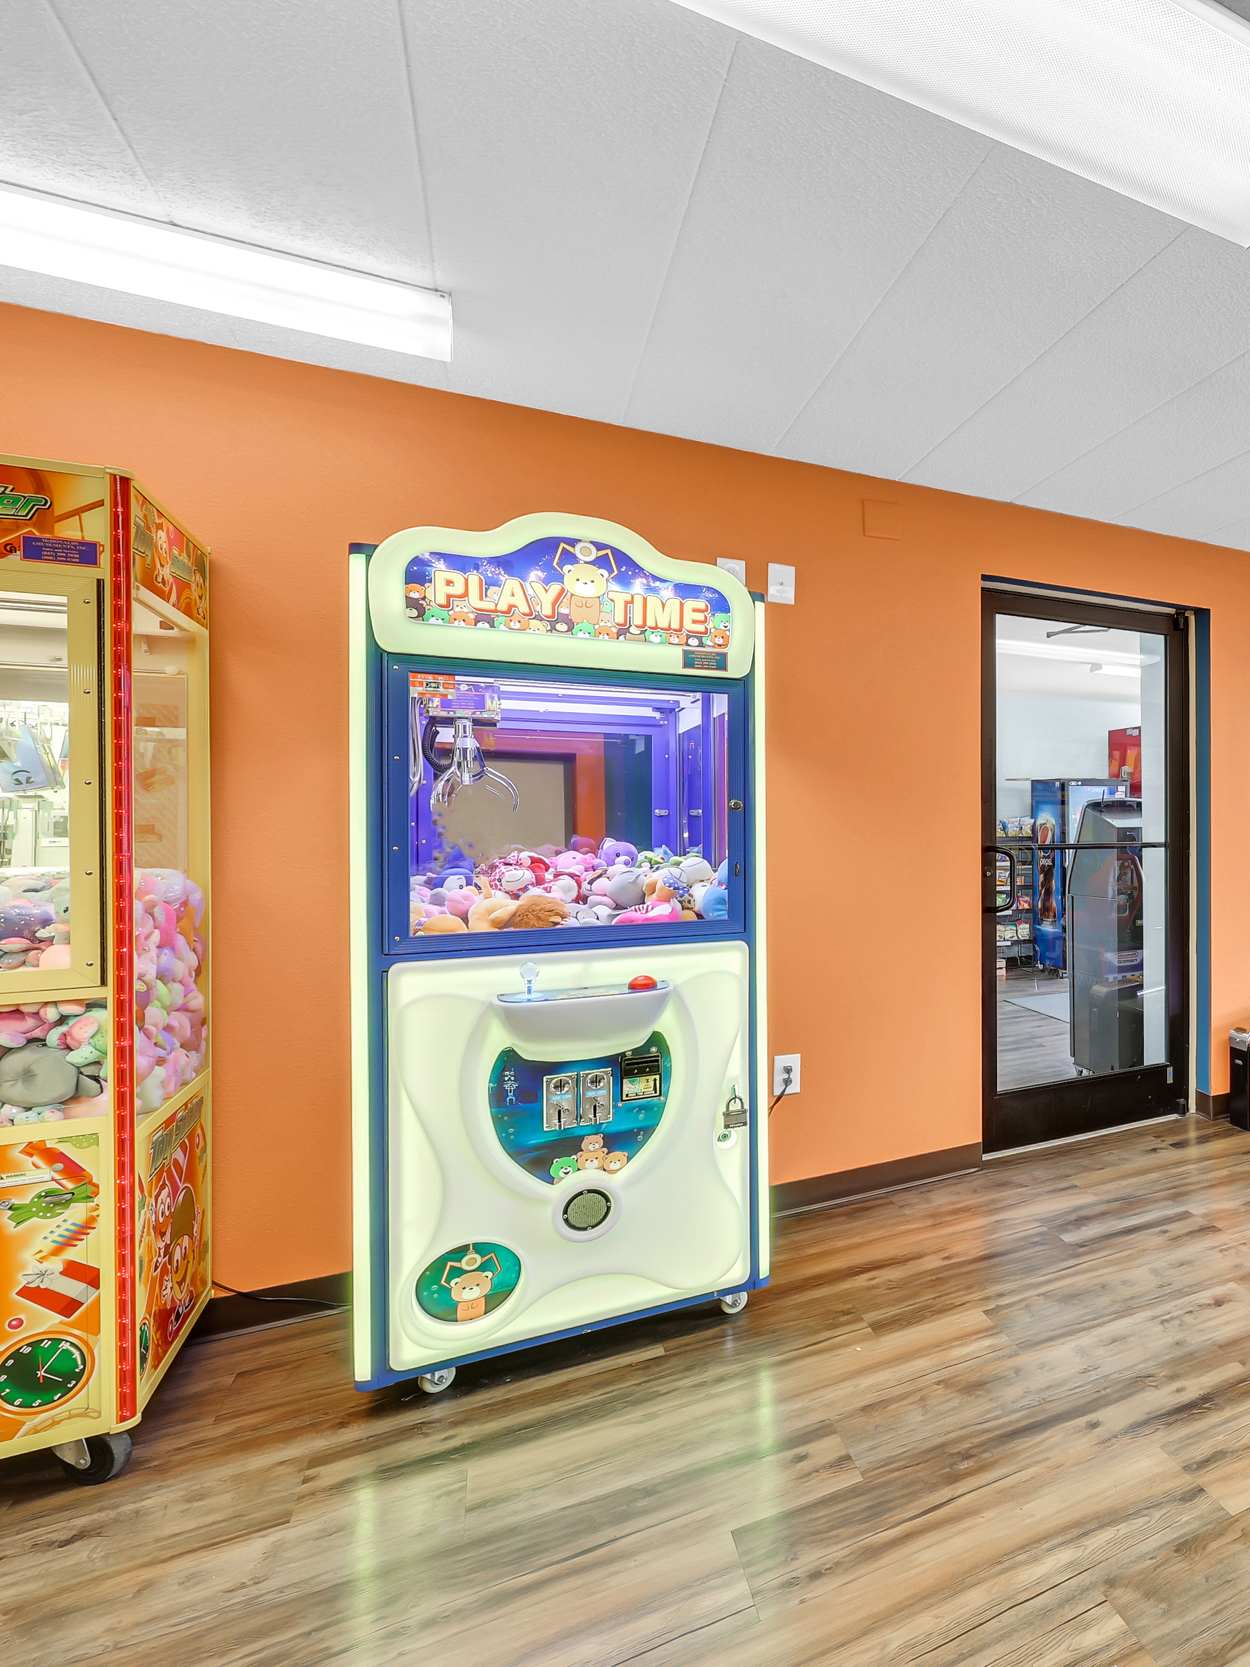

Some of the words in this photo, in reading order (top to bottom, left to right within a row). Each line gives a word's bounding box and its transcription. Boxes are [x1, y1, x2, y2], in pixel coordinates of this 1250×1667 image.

[432, 570, 567, 620] PLAY
[606, 590, 712, 637] TIME
[40, 1340, 51, 1348] 11
[19, 1345, 32, 1353] 10
[14, 1398, 23, 1406] 6
